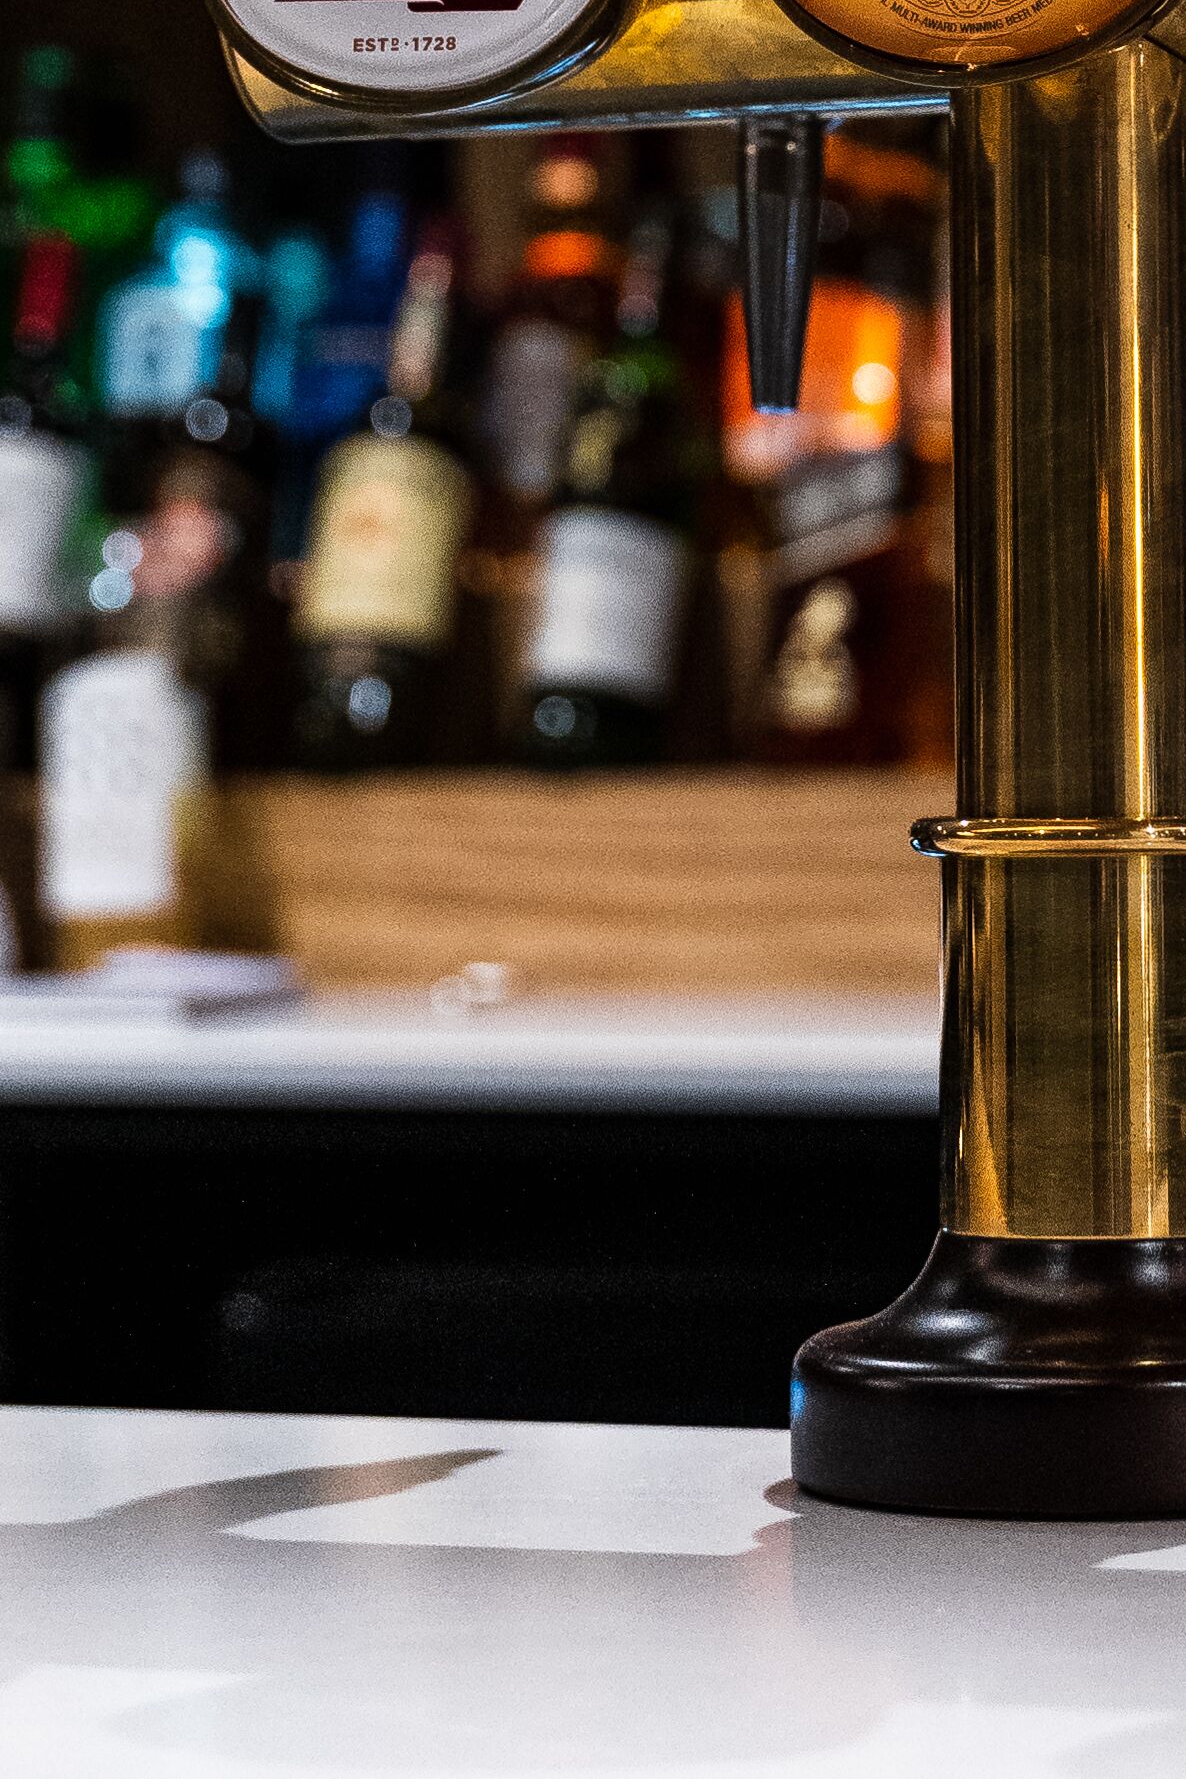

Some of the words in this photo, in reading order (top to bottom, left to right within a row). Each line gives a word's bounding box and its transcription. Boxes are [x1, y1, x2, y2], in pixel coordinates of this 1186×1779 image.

[890, 1, 957, 33] MULTI-AWARD
[960, 20, 1004, 34] WINNING
[1005, 9, 1031, 27] BEER
